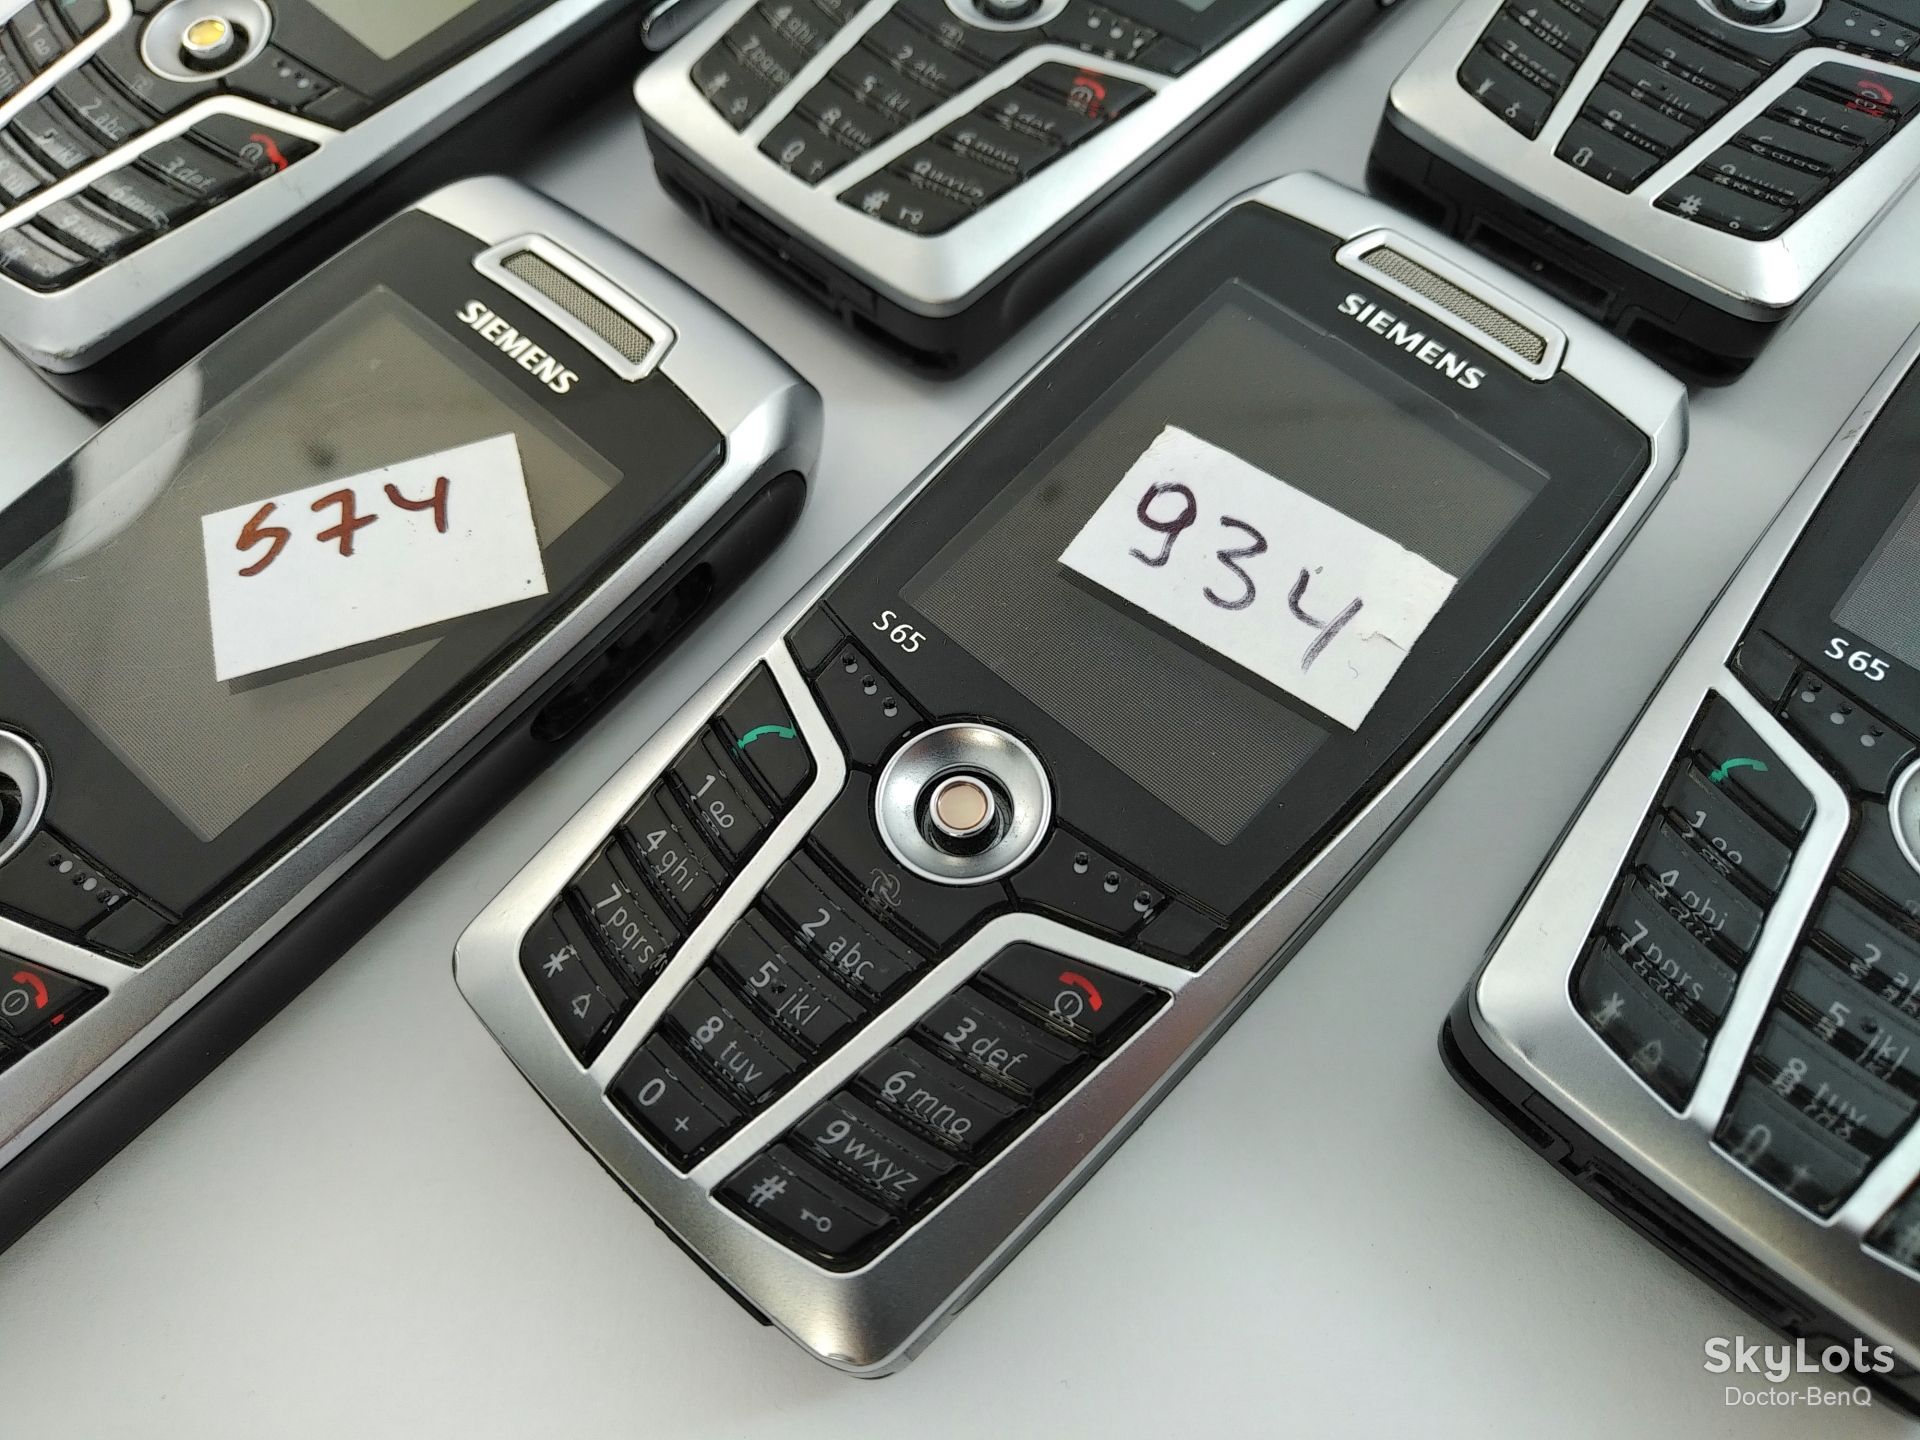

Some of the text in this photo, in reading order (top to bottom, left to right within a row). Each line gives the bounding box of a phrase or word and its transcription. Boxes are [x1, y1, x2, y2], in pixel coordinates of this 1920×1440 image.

[455, 299, 580, 394] SIEMENS
[1337, 293, 1487, 390] SIEMENS
[236, 476, 450, 577] 574
[1129, 482, 1364, 673] 934
[690, 774, 716, 802] 1
[646, 829, 699, 892] 4 ghi
[596, 883, 655, 964] 7 pqrs
[800, 908, 874, 981] 2 abc
[750, 960, 820, 1025] 5 jkl
[696, 1015, 763, 1083] 8 tuv
[943, 1017, 1029, 1075] 3 def
[638, 1078, 666, 1106] 0
[884, 1070, 972, 1137] 6 mno
[817, 1119, 918, 1192] 9 wxyz
